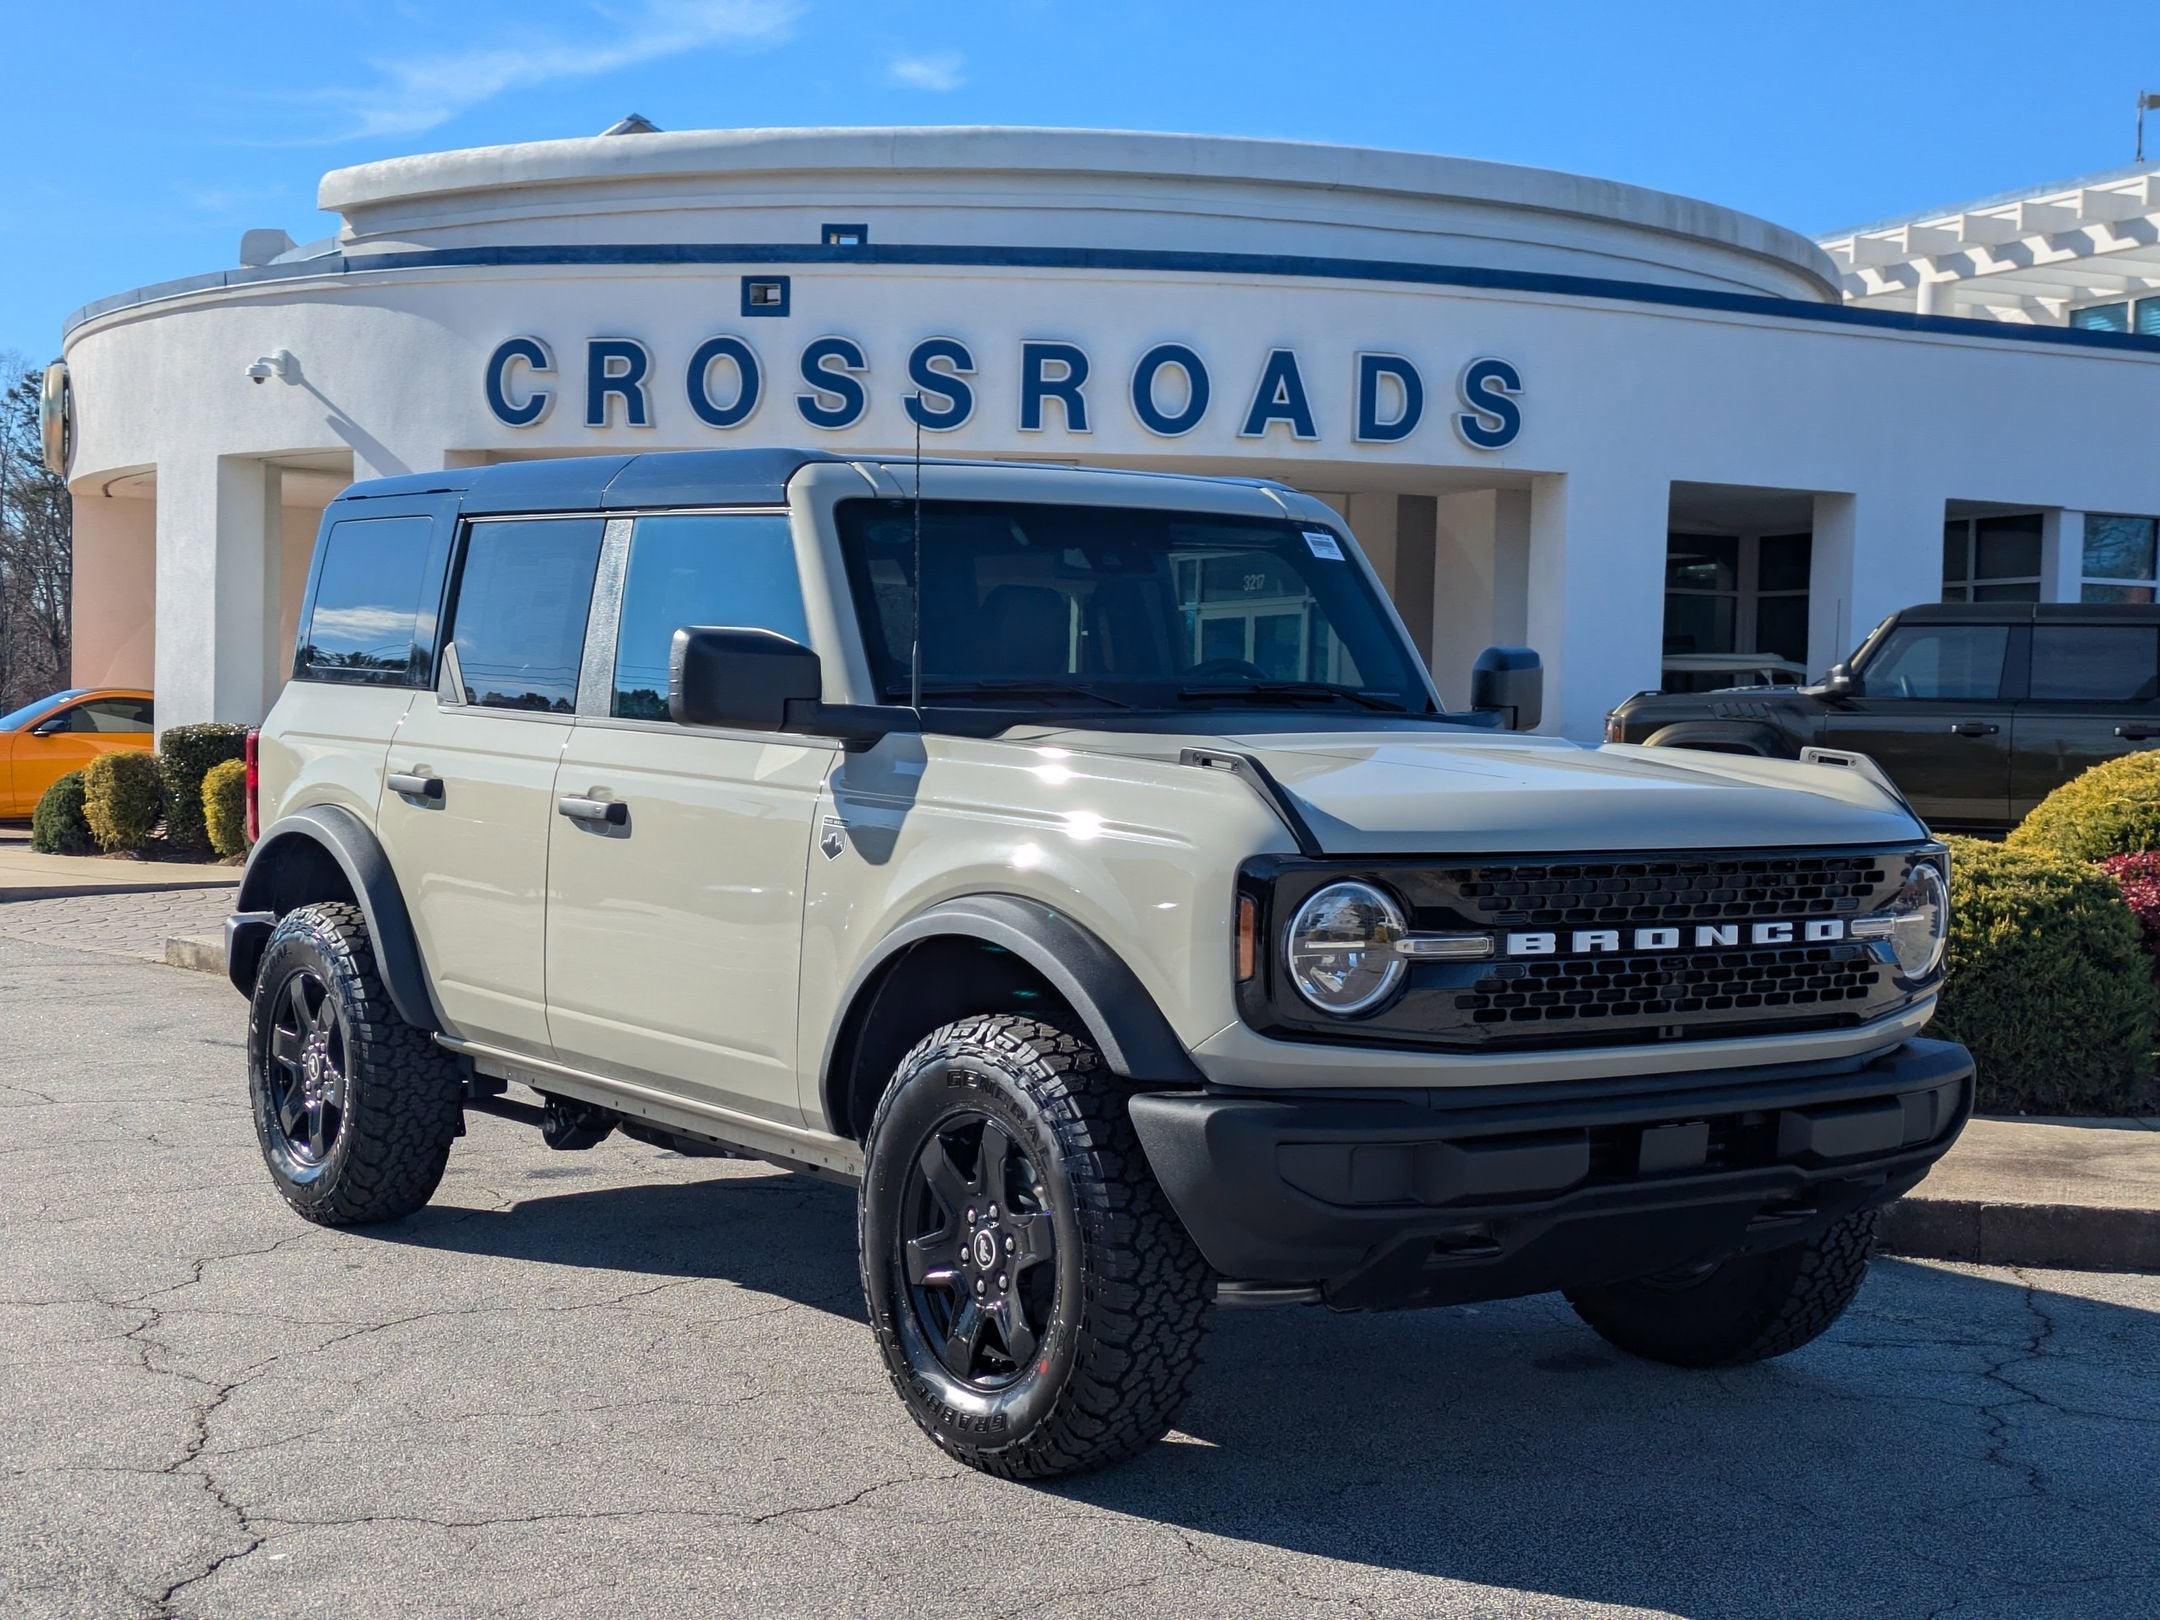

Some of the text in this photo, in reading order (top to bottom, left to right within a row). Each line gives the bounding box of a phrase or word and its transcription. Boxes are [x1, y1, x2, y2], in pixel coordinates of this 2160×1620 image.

[487, 333, 1524, 450] CROSSROADS
[1243, 574, 1265, 591] 3217
[1507, 921, 1844, 955] BRONCO
